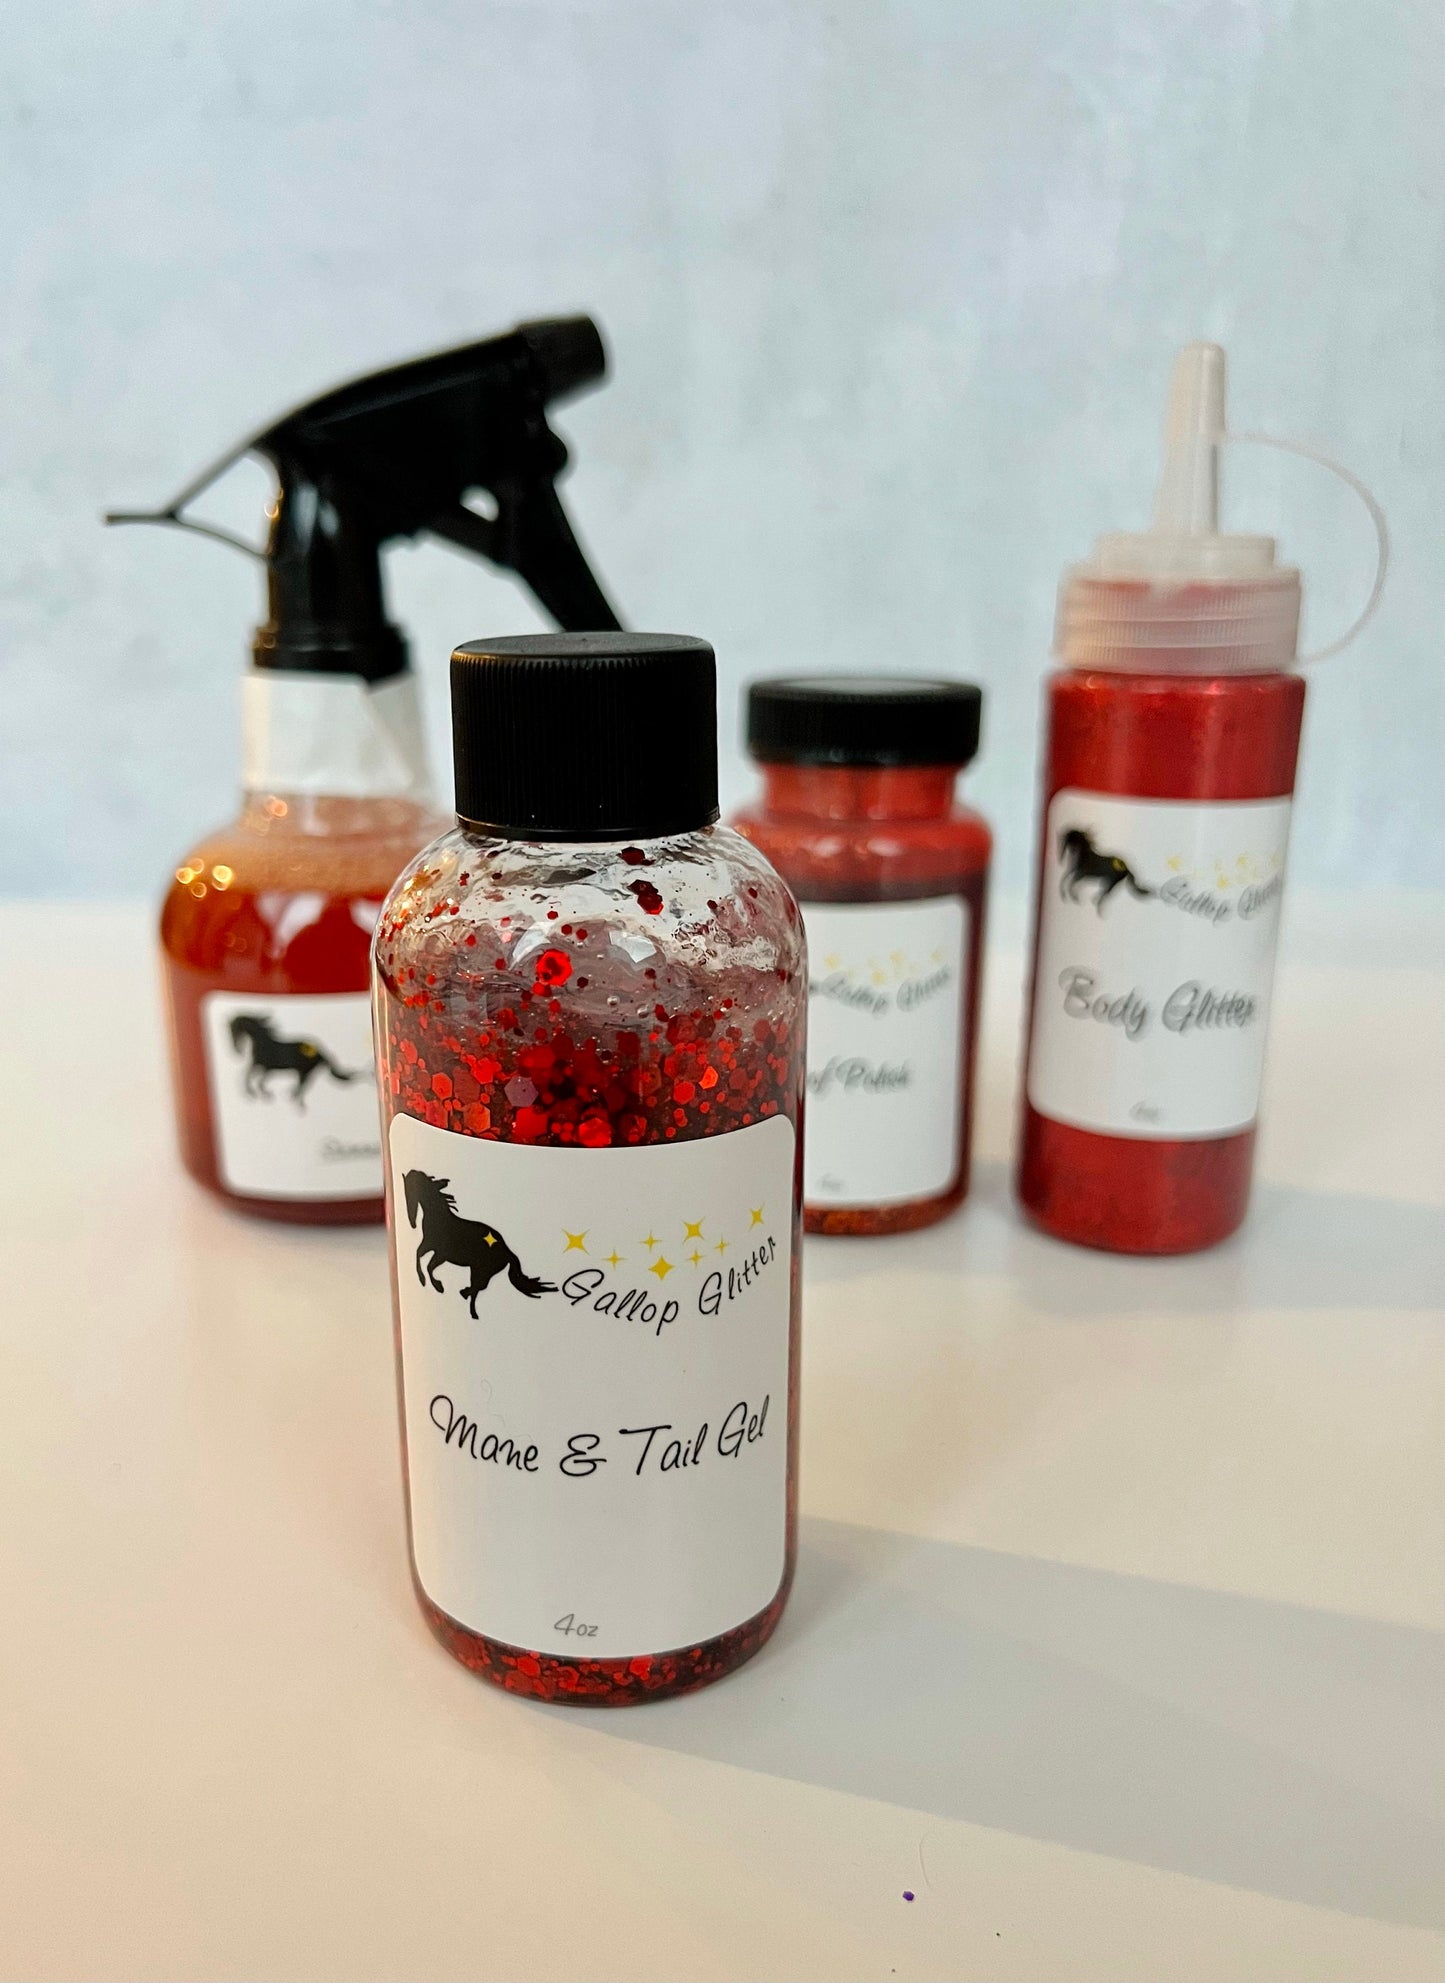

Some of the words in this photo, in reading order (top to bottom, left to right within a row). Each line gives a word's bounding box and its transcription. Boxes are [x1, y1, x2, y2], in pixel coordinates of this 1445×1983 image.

[1058, 964, 1149, 1042] Body
[561, 1268, 680, 1336] Gallop
[698, 1235, 777, 1316] Glitter
[429, 1394, 540, 1473] Mane
[559, 1433, 607, 1477] &
[618, 1424, 709, 1476] Tail
[717, 1394, 770, 1458] Gel
[553, 1613, 599, 1637] 4oz
